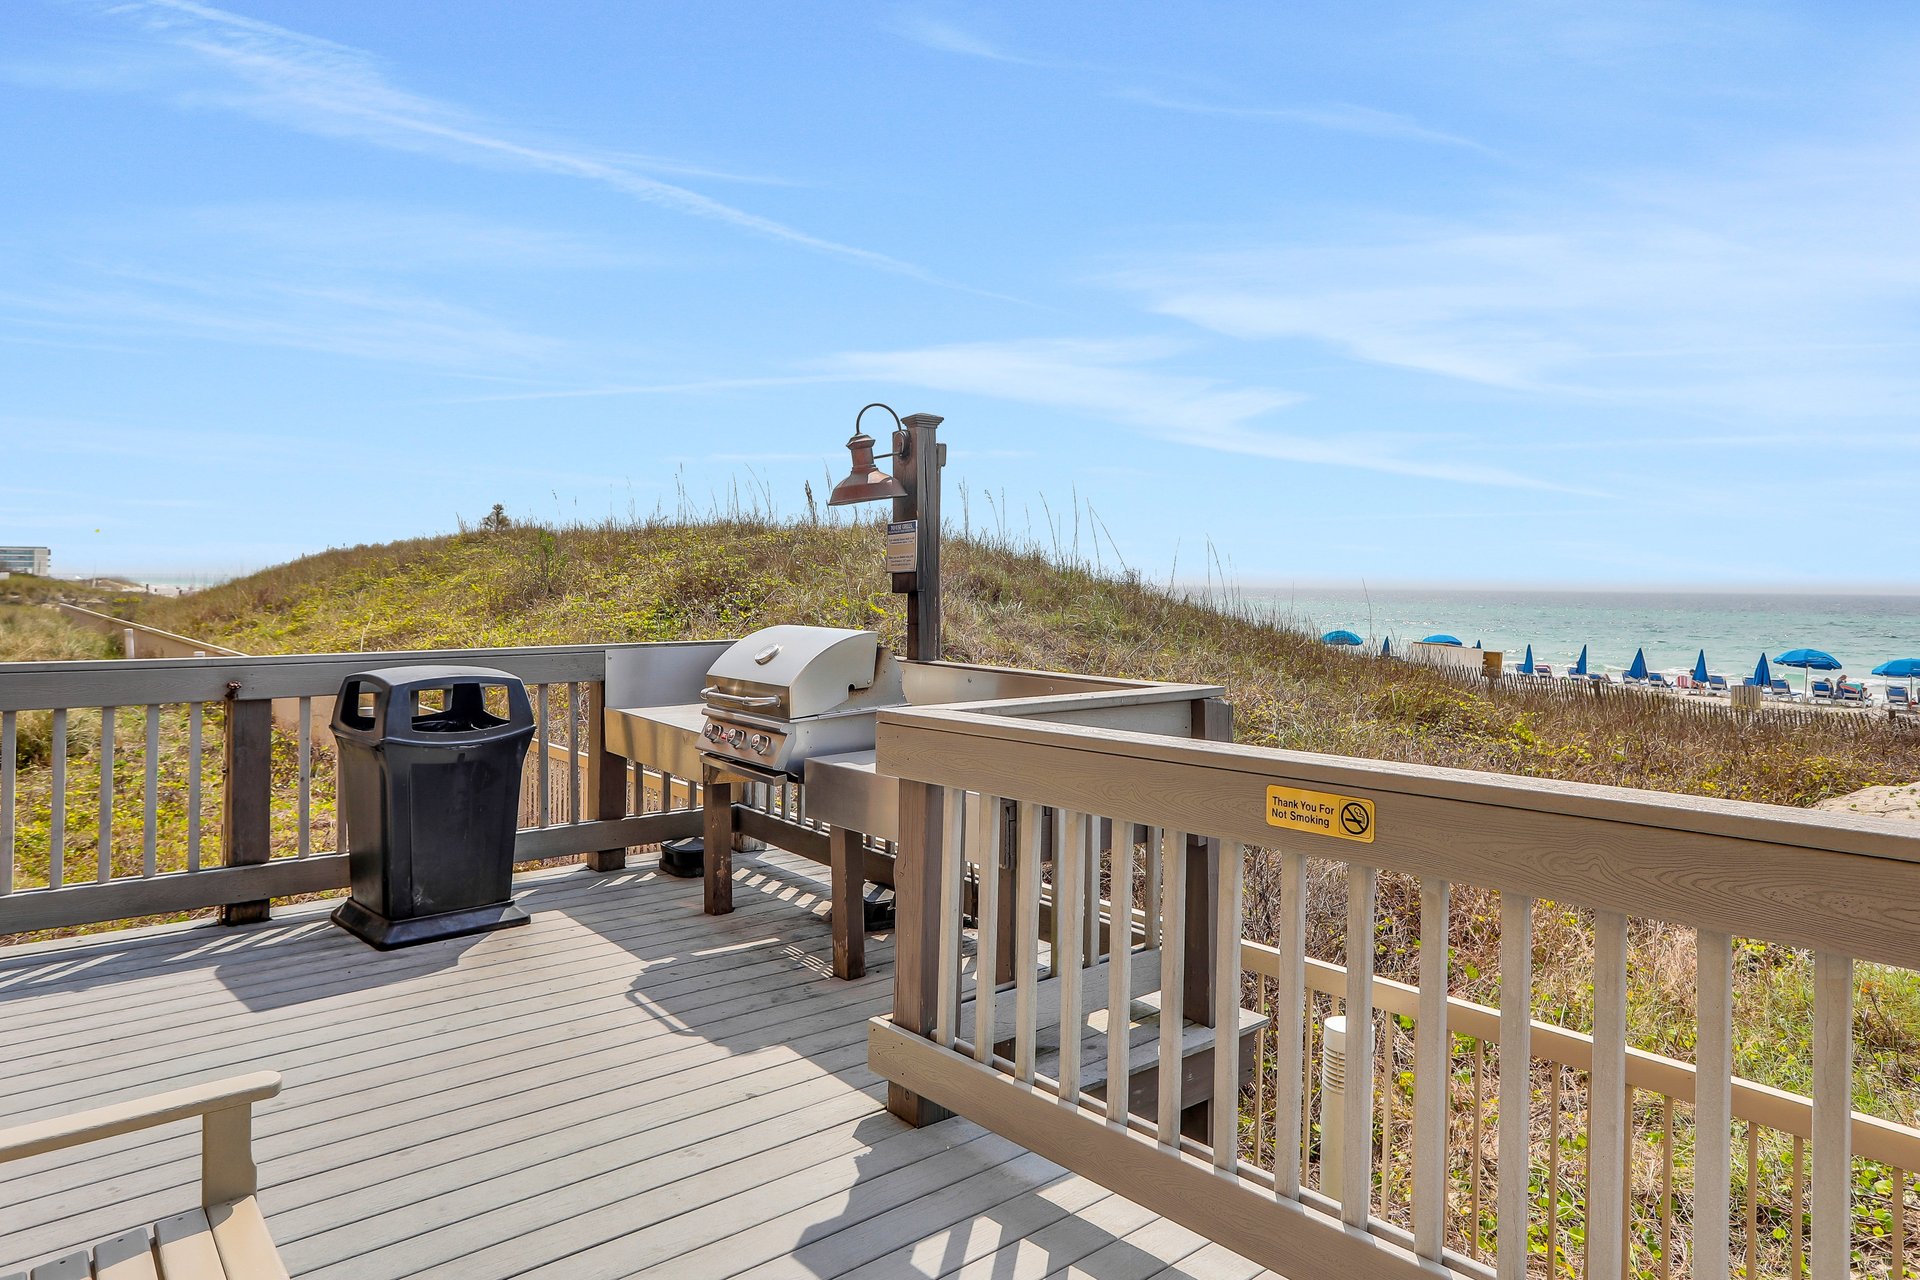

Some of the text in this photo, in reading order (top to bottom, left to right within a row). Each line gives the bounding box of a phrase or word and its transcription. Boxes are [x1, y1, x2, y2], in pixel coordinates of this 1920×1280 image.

[1272, 796, 1334, 815] Thank You For
[1271, 808, 1330, 828] Not Smoking
